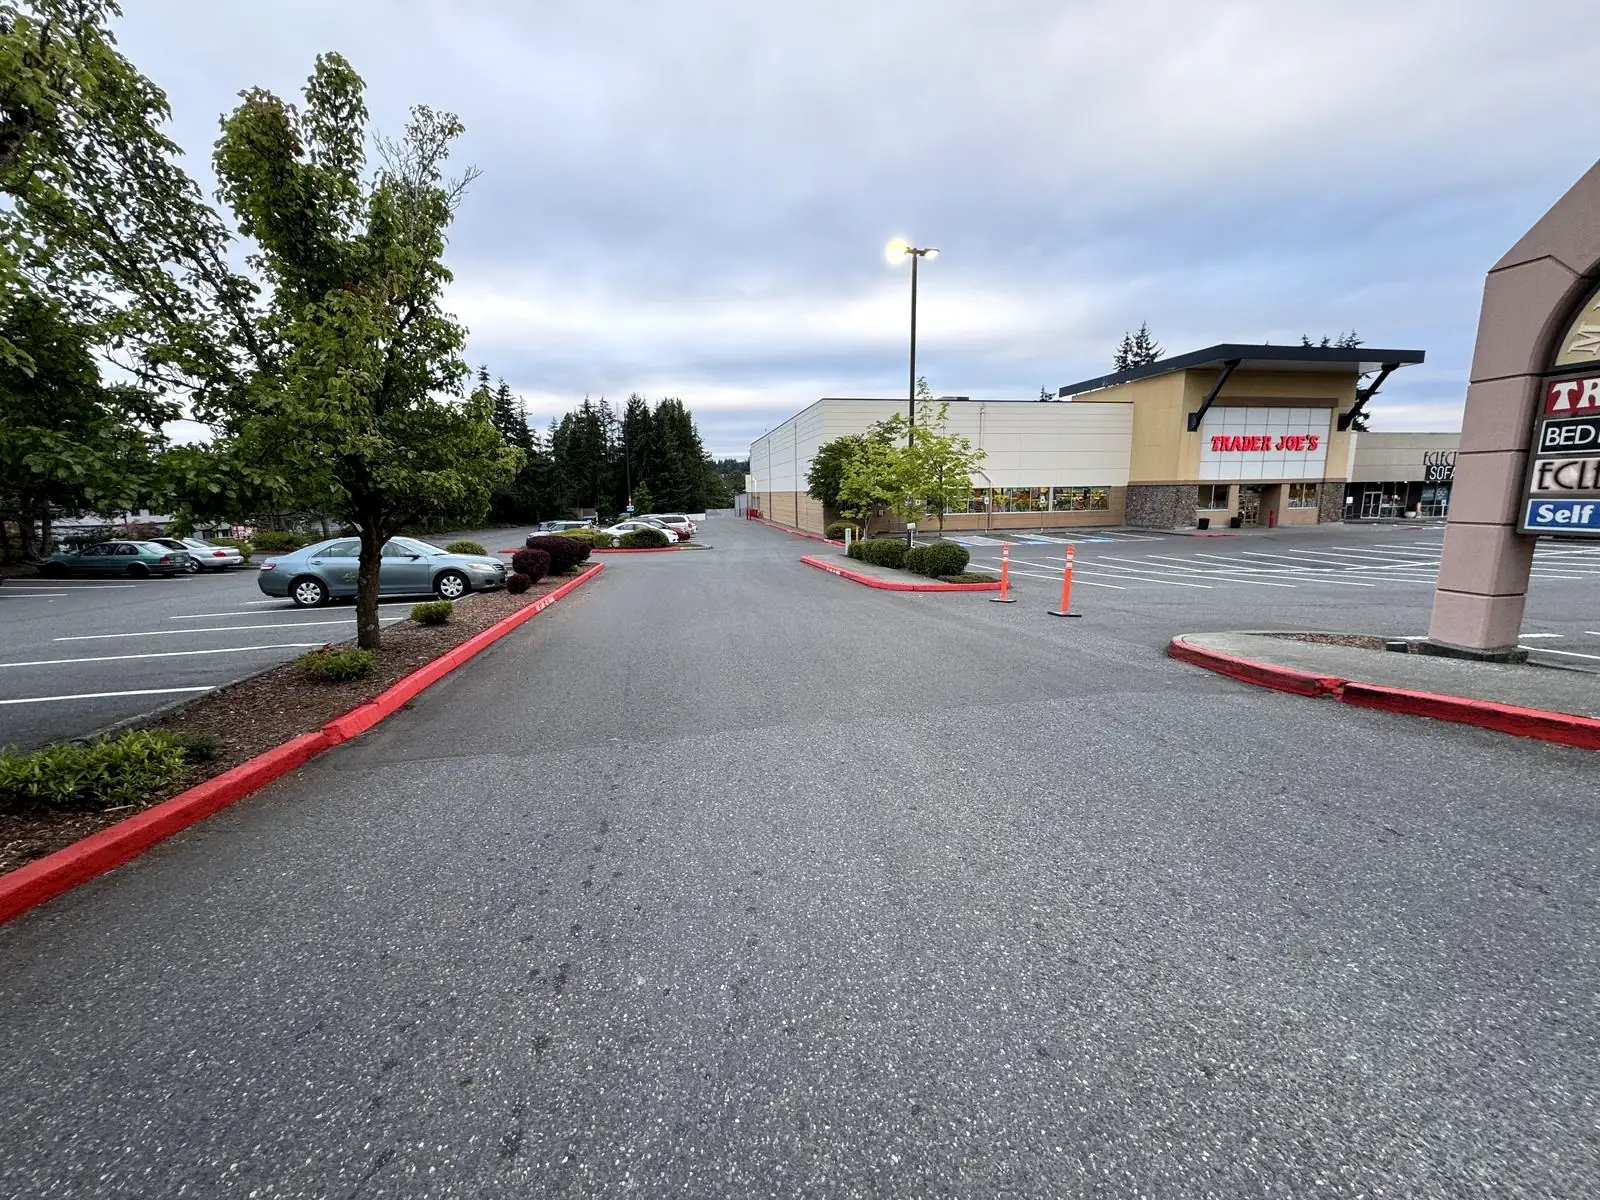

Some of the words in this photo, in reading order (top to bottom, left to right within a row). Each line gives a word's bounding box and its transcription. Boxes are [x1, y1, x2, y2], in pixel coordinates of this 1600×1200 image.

[1552, 379, 1600, 411] TR
[1211, 435, 1272, 452] TRADER
[1275, 434, 1320, 452] JOE'S
[1545, 425, 1596, 446] BED
[1536, 504, 1594, 524] Self
